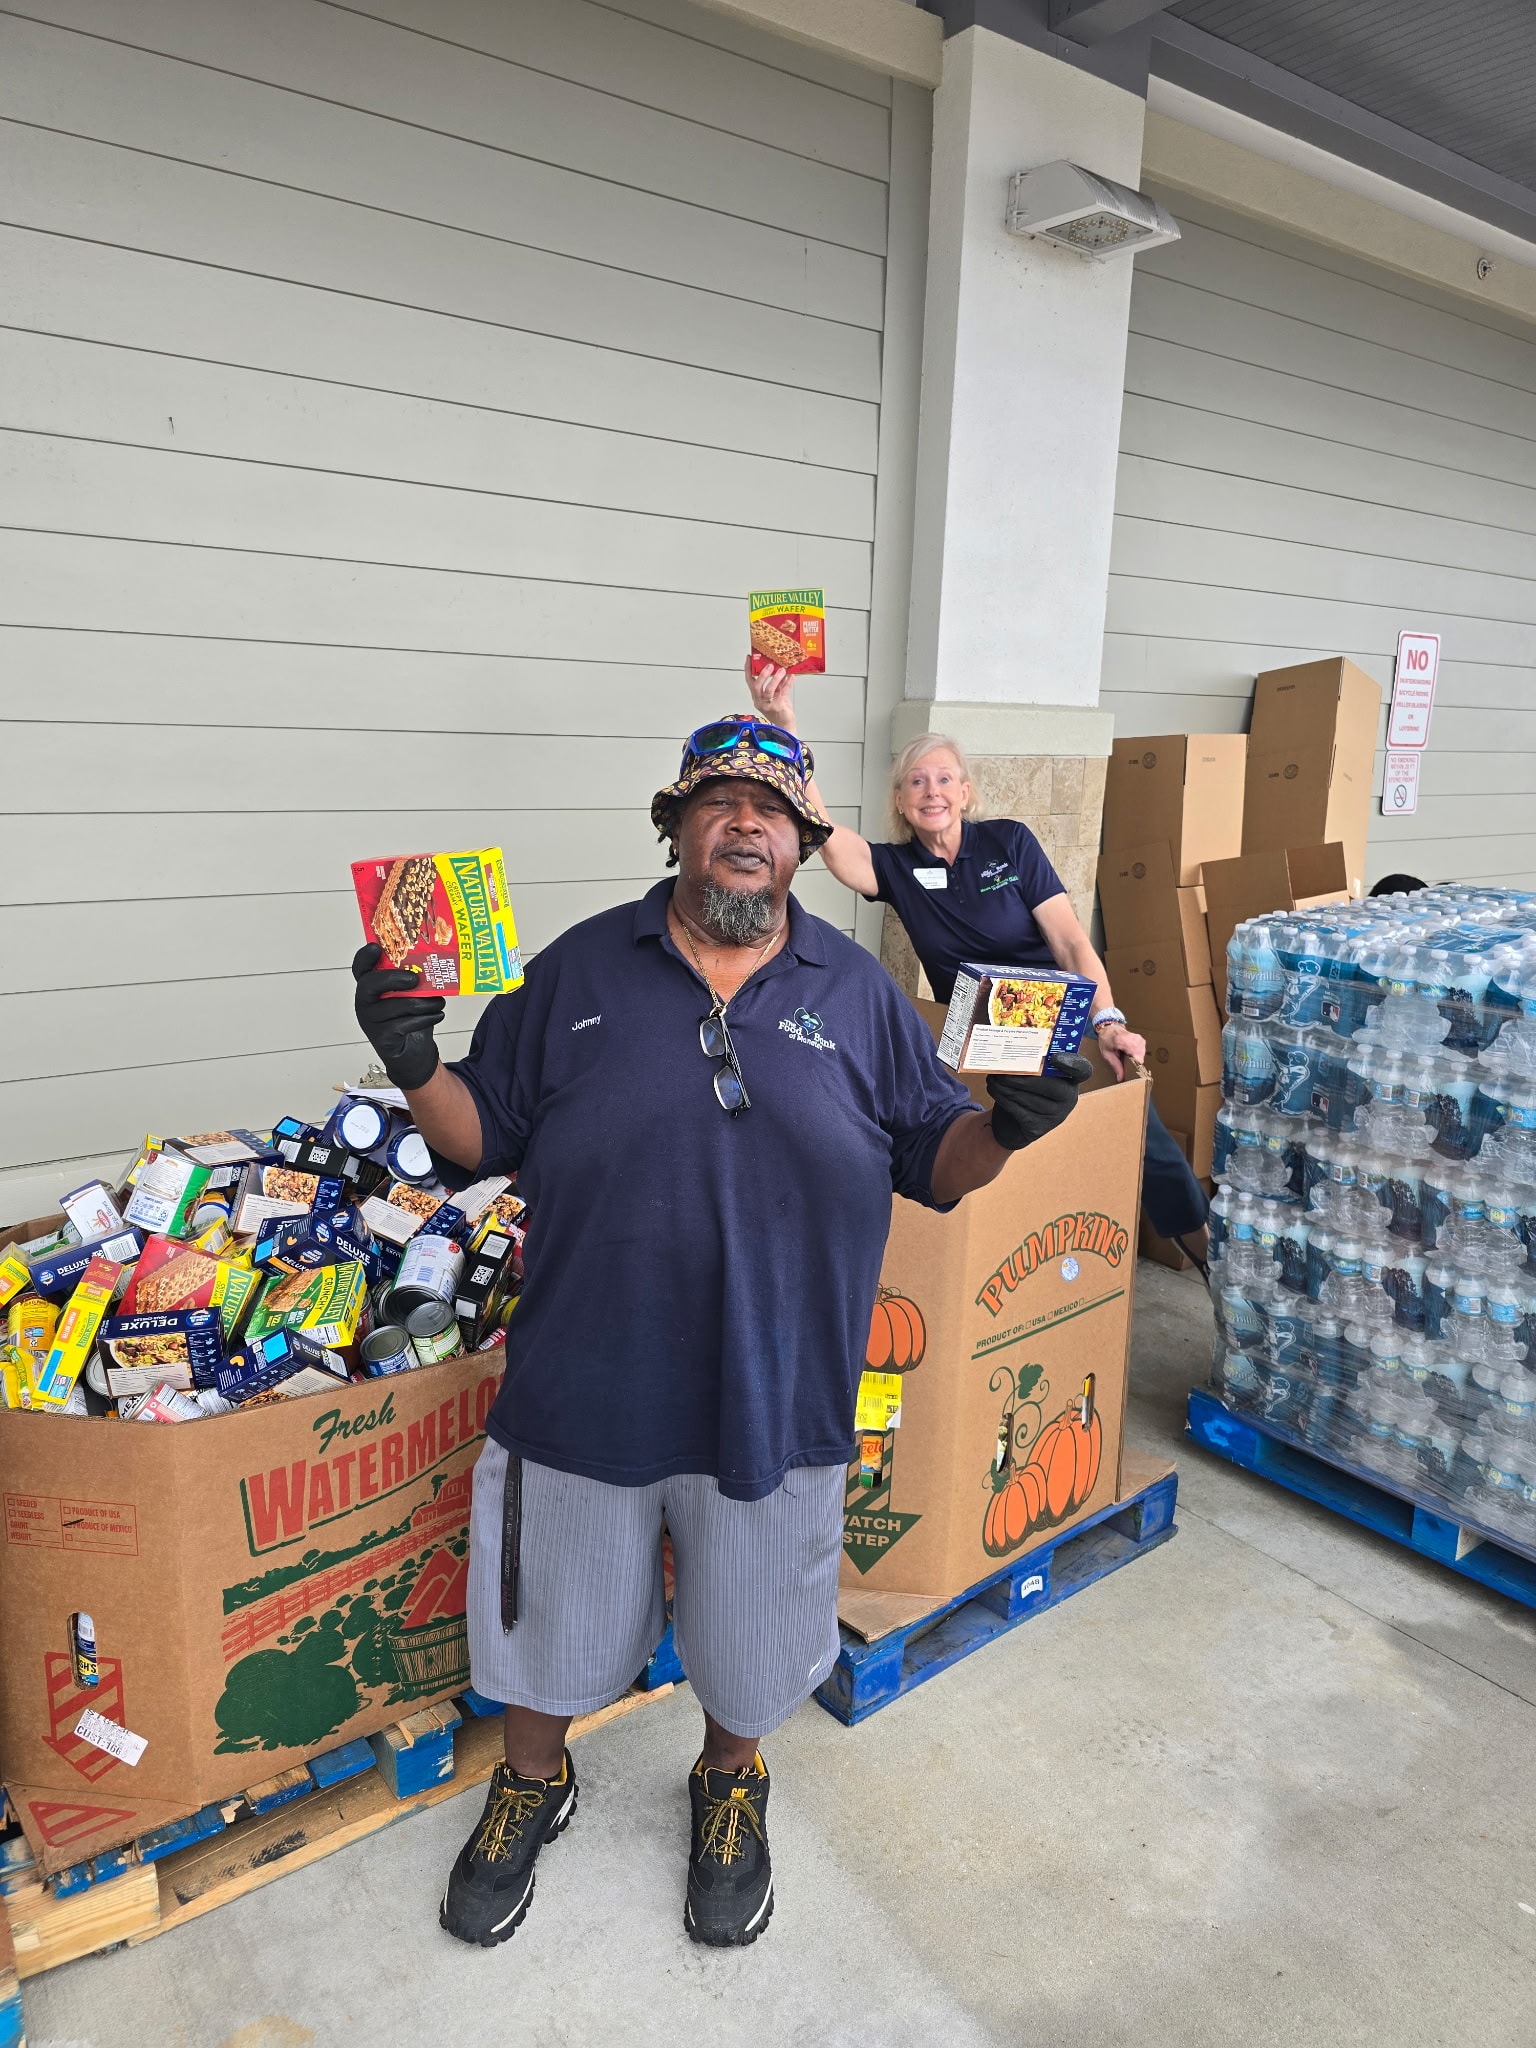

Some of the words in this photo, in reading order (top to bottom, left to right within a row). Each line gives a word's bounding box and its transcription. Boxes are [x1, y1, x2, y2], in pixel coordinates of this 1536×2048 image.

[752, 593, 787, 610] NATURE
[788, 591, 821, 606] VALLEY
[1406, 649, 1429, 671] NO
[445, 880, 458, 906] CREAMY
[451, 881, 463, 903] CRISPY
[453, 860, 488, 928] NATURE
[475, 928, 500, 988] VALLEY
[454, 908, 473, 960] WAFER
[430, 953, 445, 990] CHOCOLATE
[438, 959, 451, 983] BUTTER
[449, 958, 459, 984] PEANUT
[571, 1014, 602, 1031] Johnny
[778, 1020, 803, 1036] Food
[813, 1033, 836, 1050] Bank
[784, 1019, 797, 1028] The
[336, 1235, 371, 1265] DELUXE
[56, 1257, 91, 1275] DELUXE
[975, 1211, 1129, 1318] PUMPKINS
[336, 1263, 356, 1292] NATURE
[225, 1272, 249, 1323] NATURE
[314, 1277, 334, 1311] CRUNCHY
[321, 1292, 347, 1321] VALLEY
[119, 1317, 178, 1331] DELUXE
[976, 1328, 1012, 1349] PRODUCT
[1012, 1323, 1025, 1335] OF:
[1031, 1315, 1046, 1327] USA
[1053, 1300, 1079, 1318] MEXICO
[312, 1391, 397, 1454] Fresh
[248, 1370, 504, 1547] WATERMELO
[16, 1510, 45, 1520] SEEDLESS
[71, 1506, 99, 1518] PRODUCE
[99, 1509, 107, 1518] OF
[109, 1510, 121, 1519] USA
[10, 1521, 29, 1530] COUNT
[10, 1531, 32, 1540] WEIGHT
[73, 1520, 100, 1531] PRODUCE
[101, 1522, 109, 1532] OF
[109, 1523, 132, 1534] MEXICO
[843, 1532, 890, 1548] STEP
[730, 1787, 749, 1798] CAT
